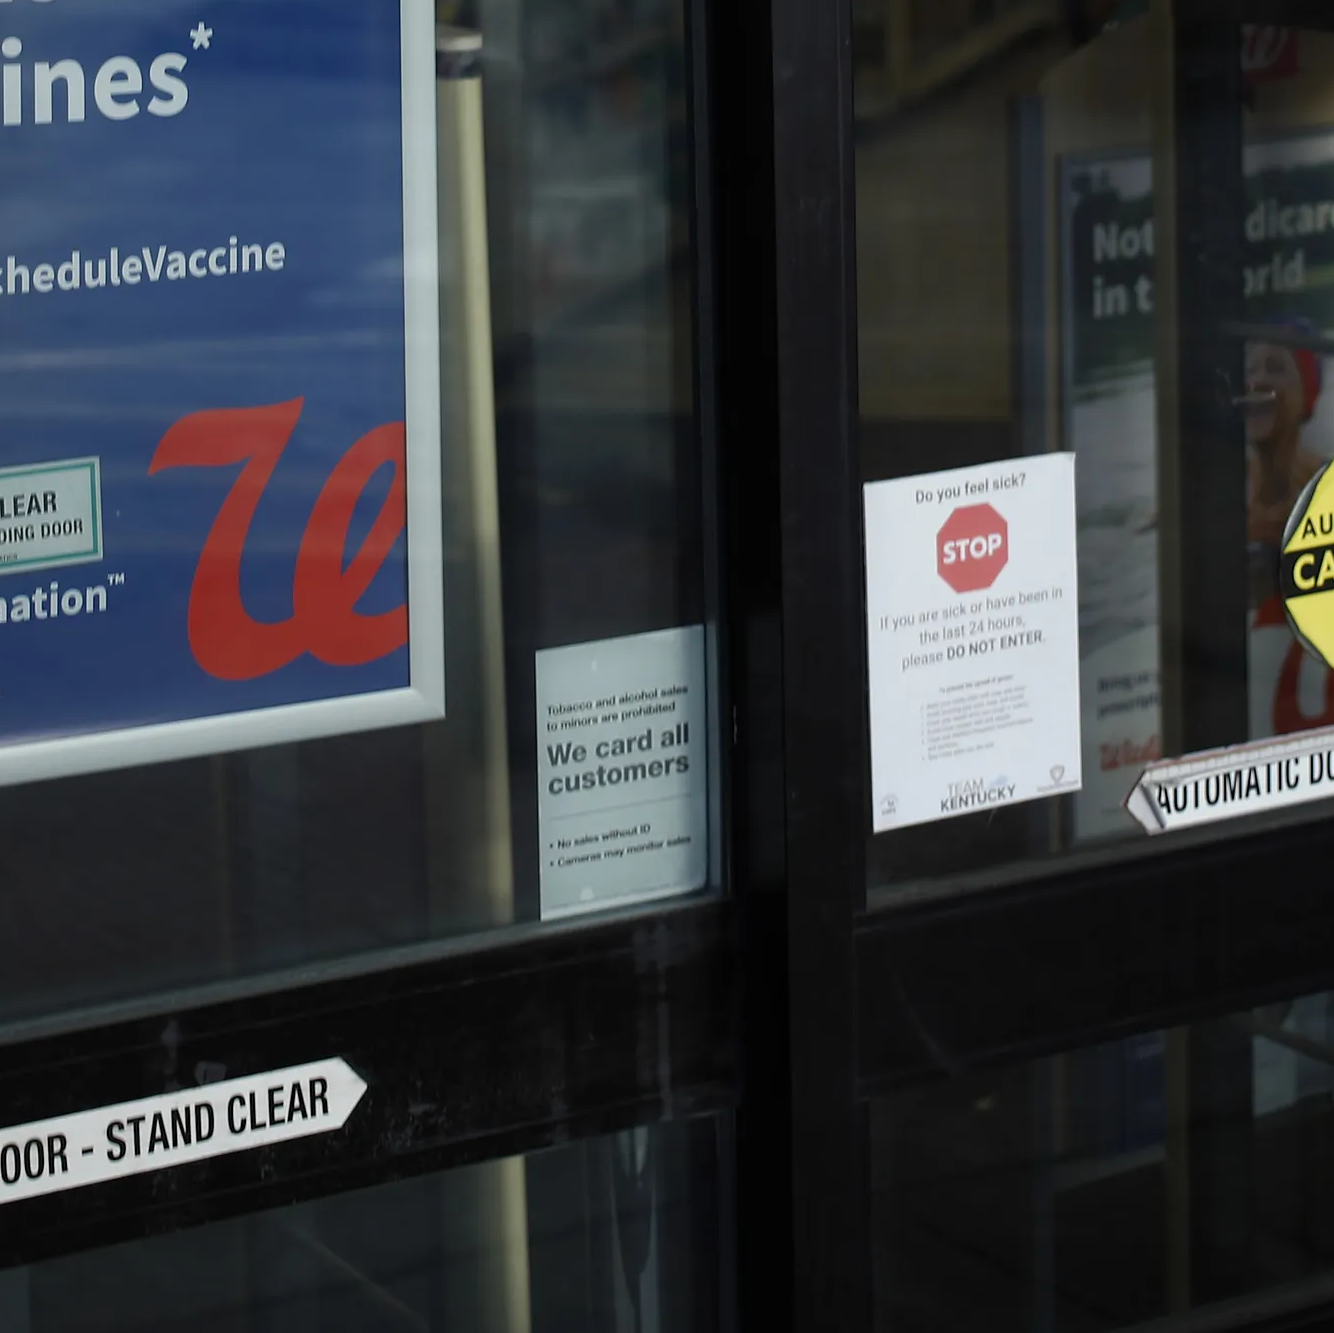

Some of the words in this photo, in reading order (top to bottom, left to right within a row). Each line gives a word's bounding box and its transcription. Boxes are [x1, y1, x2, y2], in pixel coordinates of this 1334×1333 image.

[916, 491, 933, 504] Do
[937, 486, 961, 503] you
[965, 479, 989, 495] feel
[993, 473, 1026, 491] sick?
[41, 518, 83, 540] DOOR
[943, 533, 1003, 565] STOP
[880, 616, 889, 631] If
[892, 614, 915, 632] you
[919, 610, 938, 623] are
[942, 604, 966, 620] sick
[970, 602, 982, 613] or
[986, 596, 1015, 612] have
[1019, 590, 1048, 605] been
[1051, 586, 1063, 599] in
[919, 629, 939, 645] the
[942, 624, 966, 640] last
[969, 622, 984, 635] 24
[988, 615, 1026, 634] hours,
[902, 650, 943, 671] please
[947, 646, 965, 661] DO
[969, 639, 997, 656] NOT
[1000, 630, 1047, 651] ENTER.
[547, 701, 593, 717] Tobacco
[595, 696, 616, 710] and
[618, 688, 658, 705] alcohol
[661, 684, 689, 697] sales
[546, 722, 558, 733] to
[561, 716, 598, 730] minors
[601, 714, 618, 724] are
[621, 701, 676, 722] prohibited
[547, 742, 587, 768] We
[595, 728, 652, 759] card
[660, 722, 689, 749] all
[548, 754, 690, 795] customers
[948, 777, 984, 799] TEAM
[1158, 756, 1300, 815] AUTOMATIC
[940, 784, 1016, 812] KENTUCKY
[557, 838, 572, 850] No
[574, 834, 600, 847] sales
[602, 826, 638, 842] without
[640, 823, 651, 835] ID
[557, 853, 602, 868] Cameras
[604, 847, 624, 860] may
[626, 840, 664, 855] monitor
[666, 835, 692, 848] sales
[106, 1103, 216, 1162] STAND
[227, 1076, 330, 1137] CLEAR
